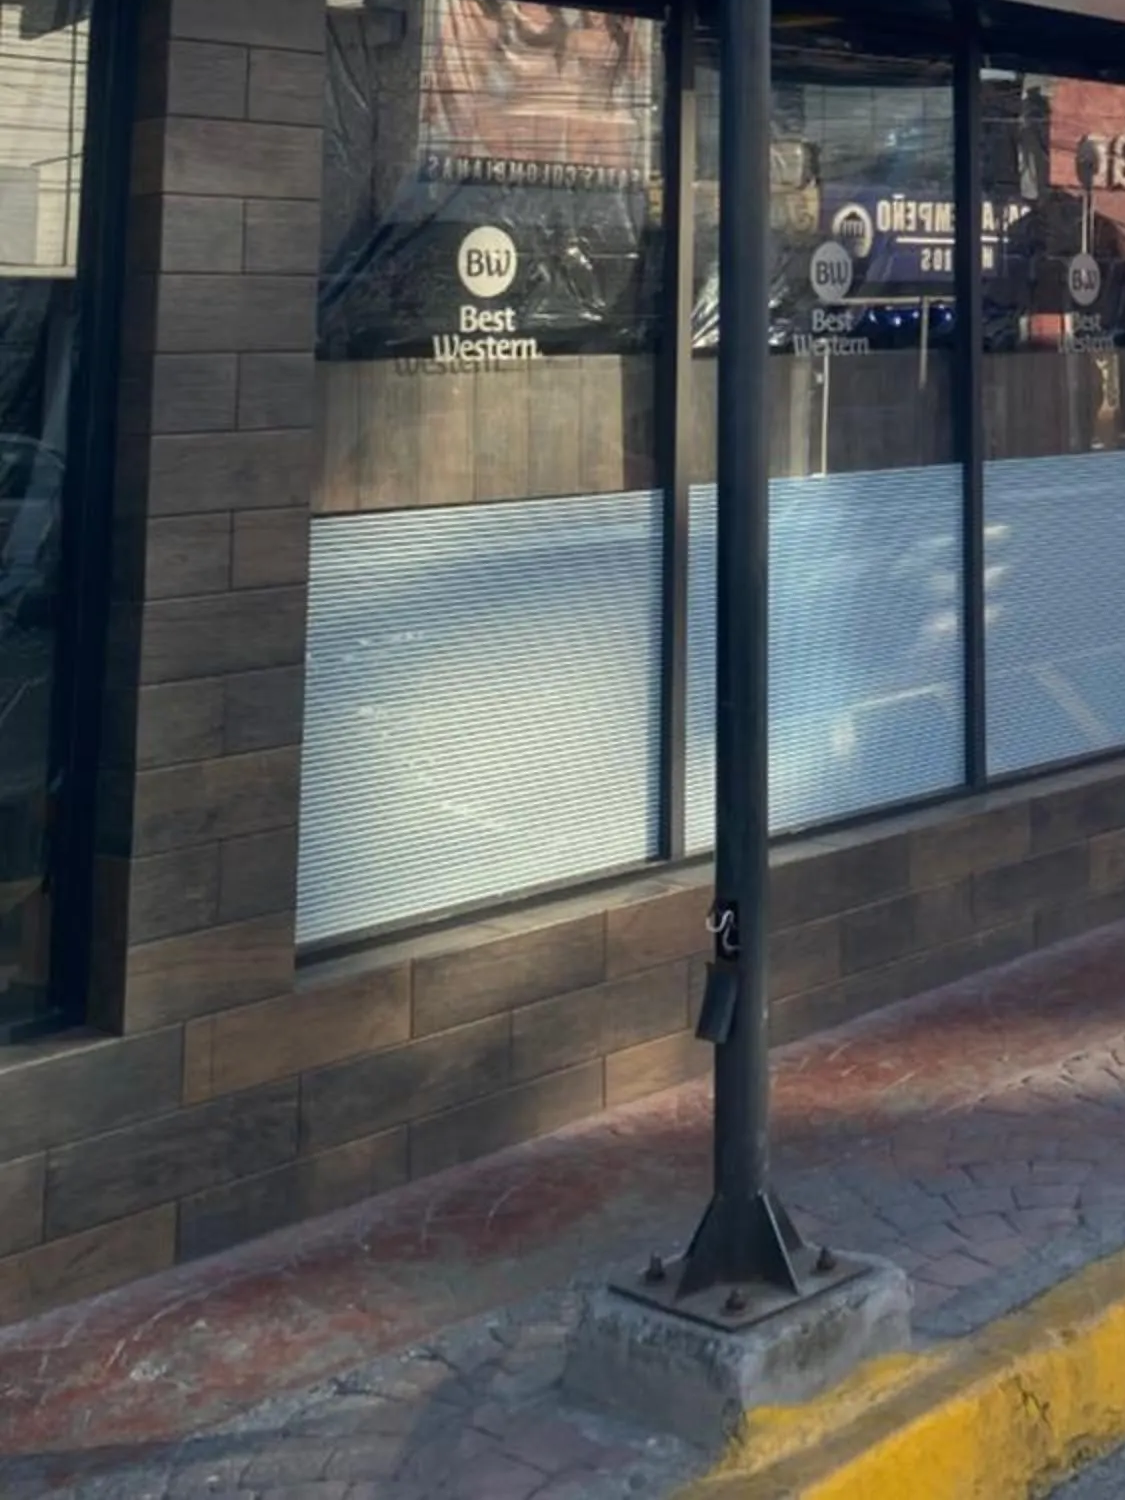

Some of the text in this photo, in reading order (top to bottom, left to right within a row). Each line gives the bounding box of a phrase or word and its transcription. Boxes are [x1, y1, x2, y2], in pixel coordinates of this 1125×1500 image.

[459, 304, 517, 334] Best
[812, 308, 855, 332] Best
[432, 332, 542, 361] Western
[792, 334, 870, 357] Western
